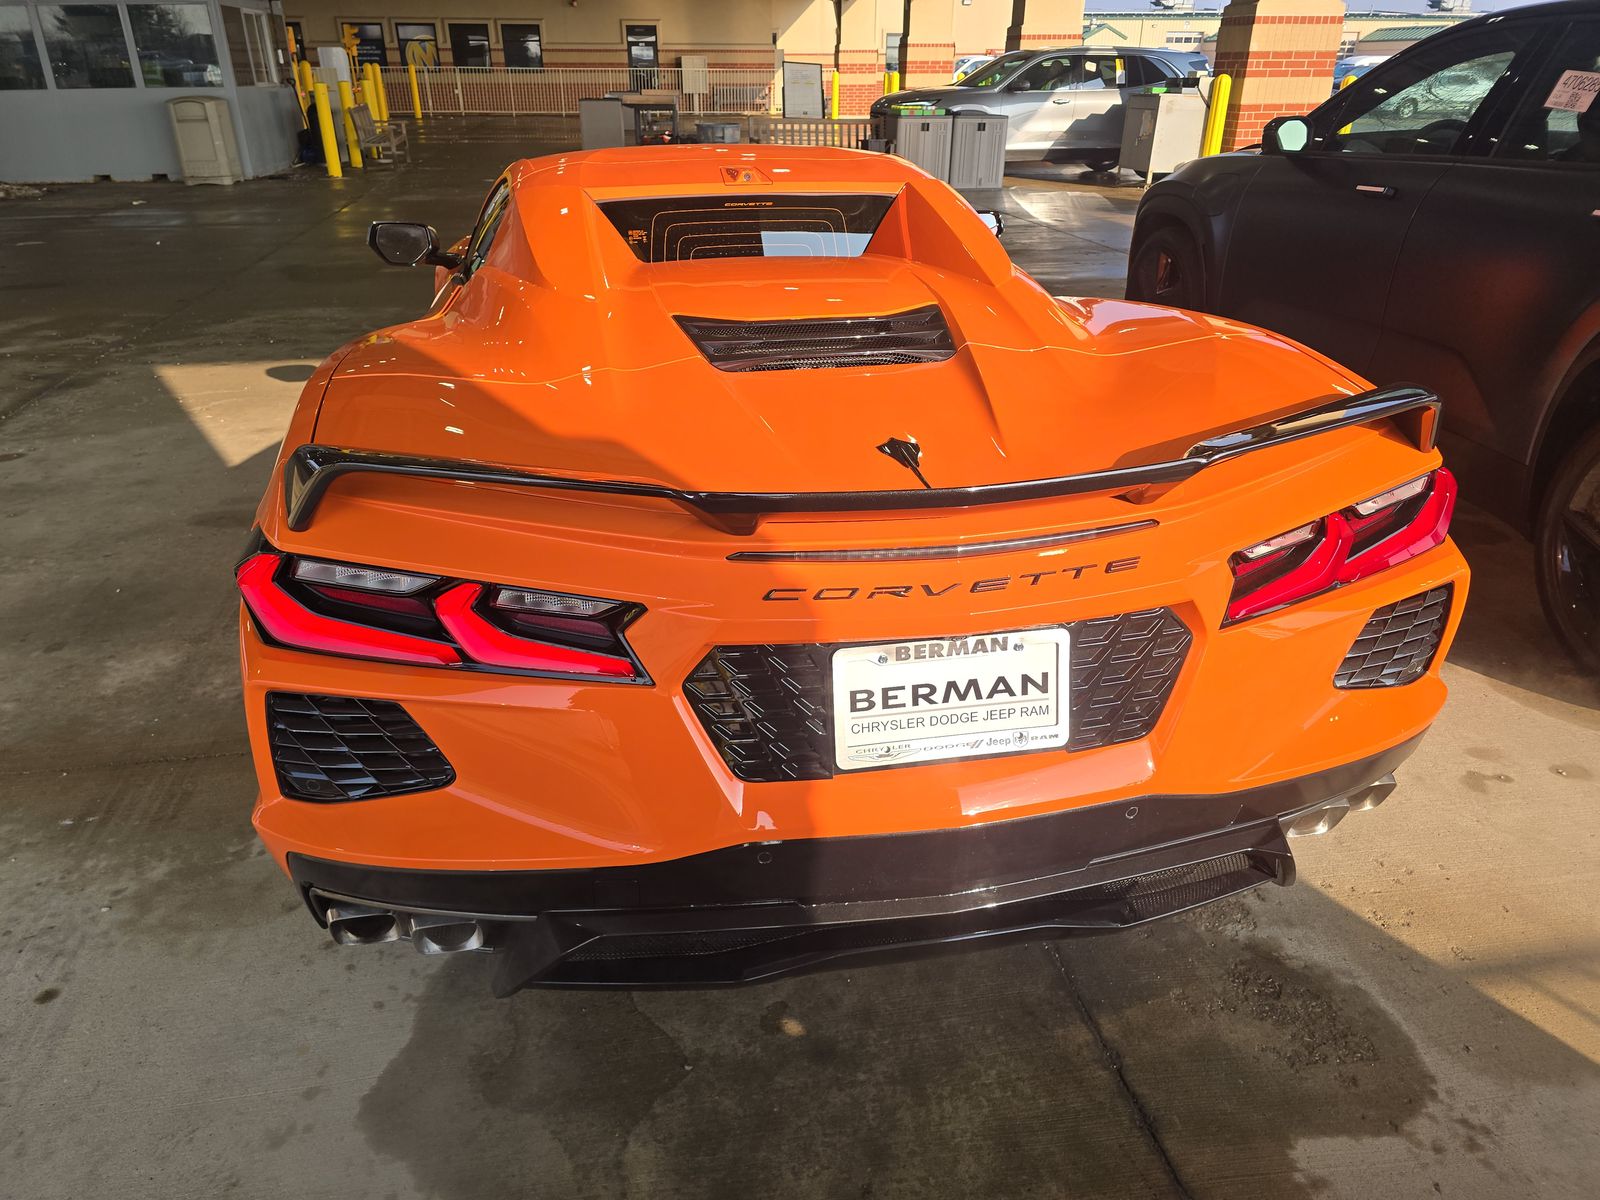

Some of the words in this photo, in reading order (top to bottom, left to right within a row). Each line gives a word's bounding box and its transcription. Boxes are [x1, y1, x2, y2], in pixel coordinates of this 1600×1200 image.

[762, 556, 1141, 601] CORVETTE
[895, 636, 1009, 661] BERMAN
[849, 672, 1049, 713] BERMAN
[851, 717, 925, 735] CHRYSLER
[929, 711, 979, 727] DODGE
[982, 707, 1016, 721] JEEP
[1020, 705, 1049, 717] RAM
[855, 743, 912, 755] CHRYLER
[986, 737, 1011, 748] Jeep
[1031, 733, 1059, 741] RAM
